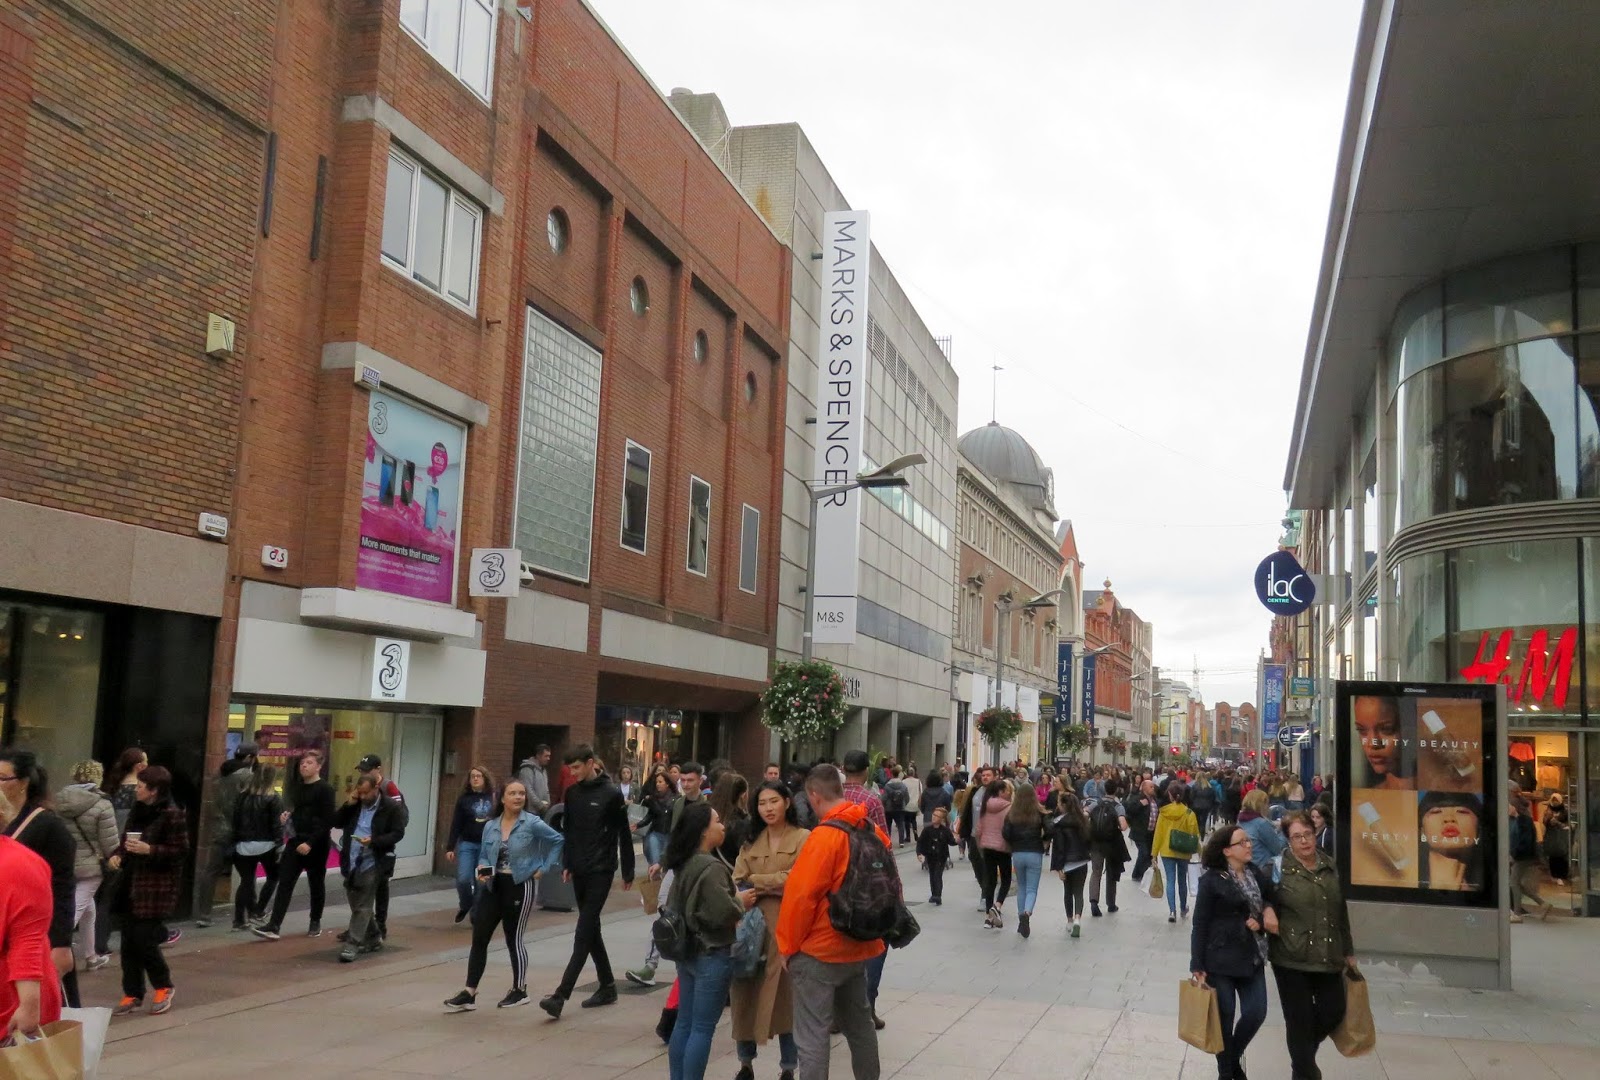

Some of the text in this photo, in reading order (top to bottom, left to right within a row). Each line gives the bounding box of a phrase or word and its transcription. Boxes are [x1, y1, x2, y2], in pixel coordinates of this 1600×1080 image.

[823, 220, 857, 508] MARKS & SPENCER
[372, 401, 388, 434] 3
[361, 536, 378, 548] More
[379, 541, 408, 556] moments
[408, 548, 420, 558] that
[479, 552, 506, 588] 3
[816, 611, 845, 623] M&S
[379, 643, 402, 690] 3
[1361, 738, 1480, 749] FENTY BEAUTY
[1419, 834, 1480, 845] BEAUTY
